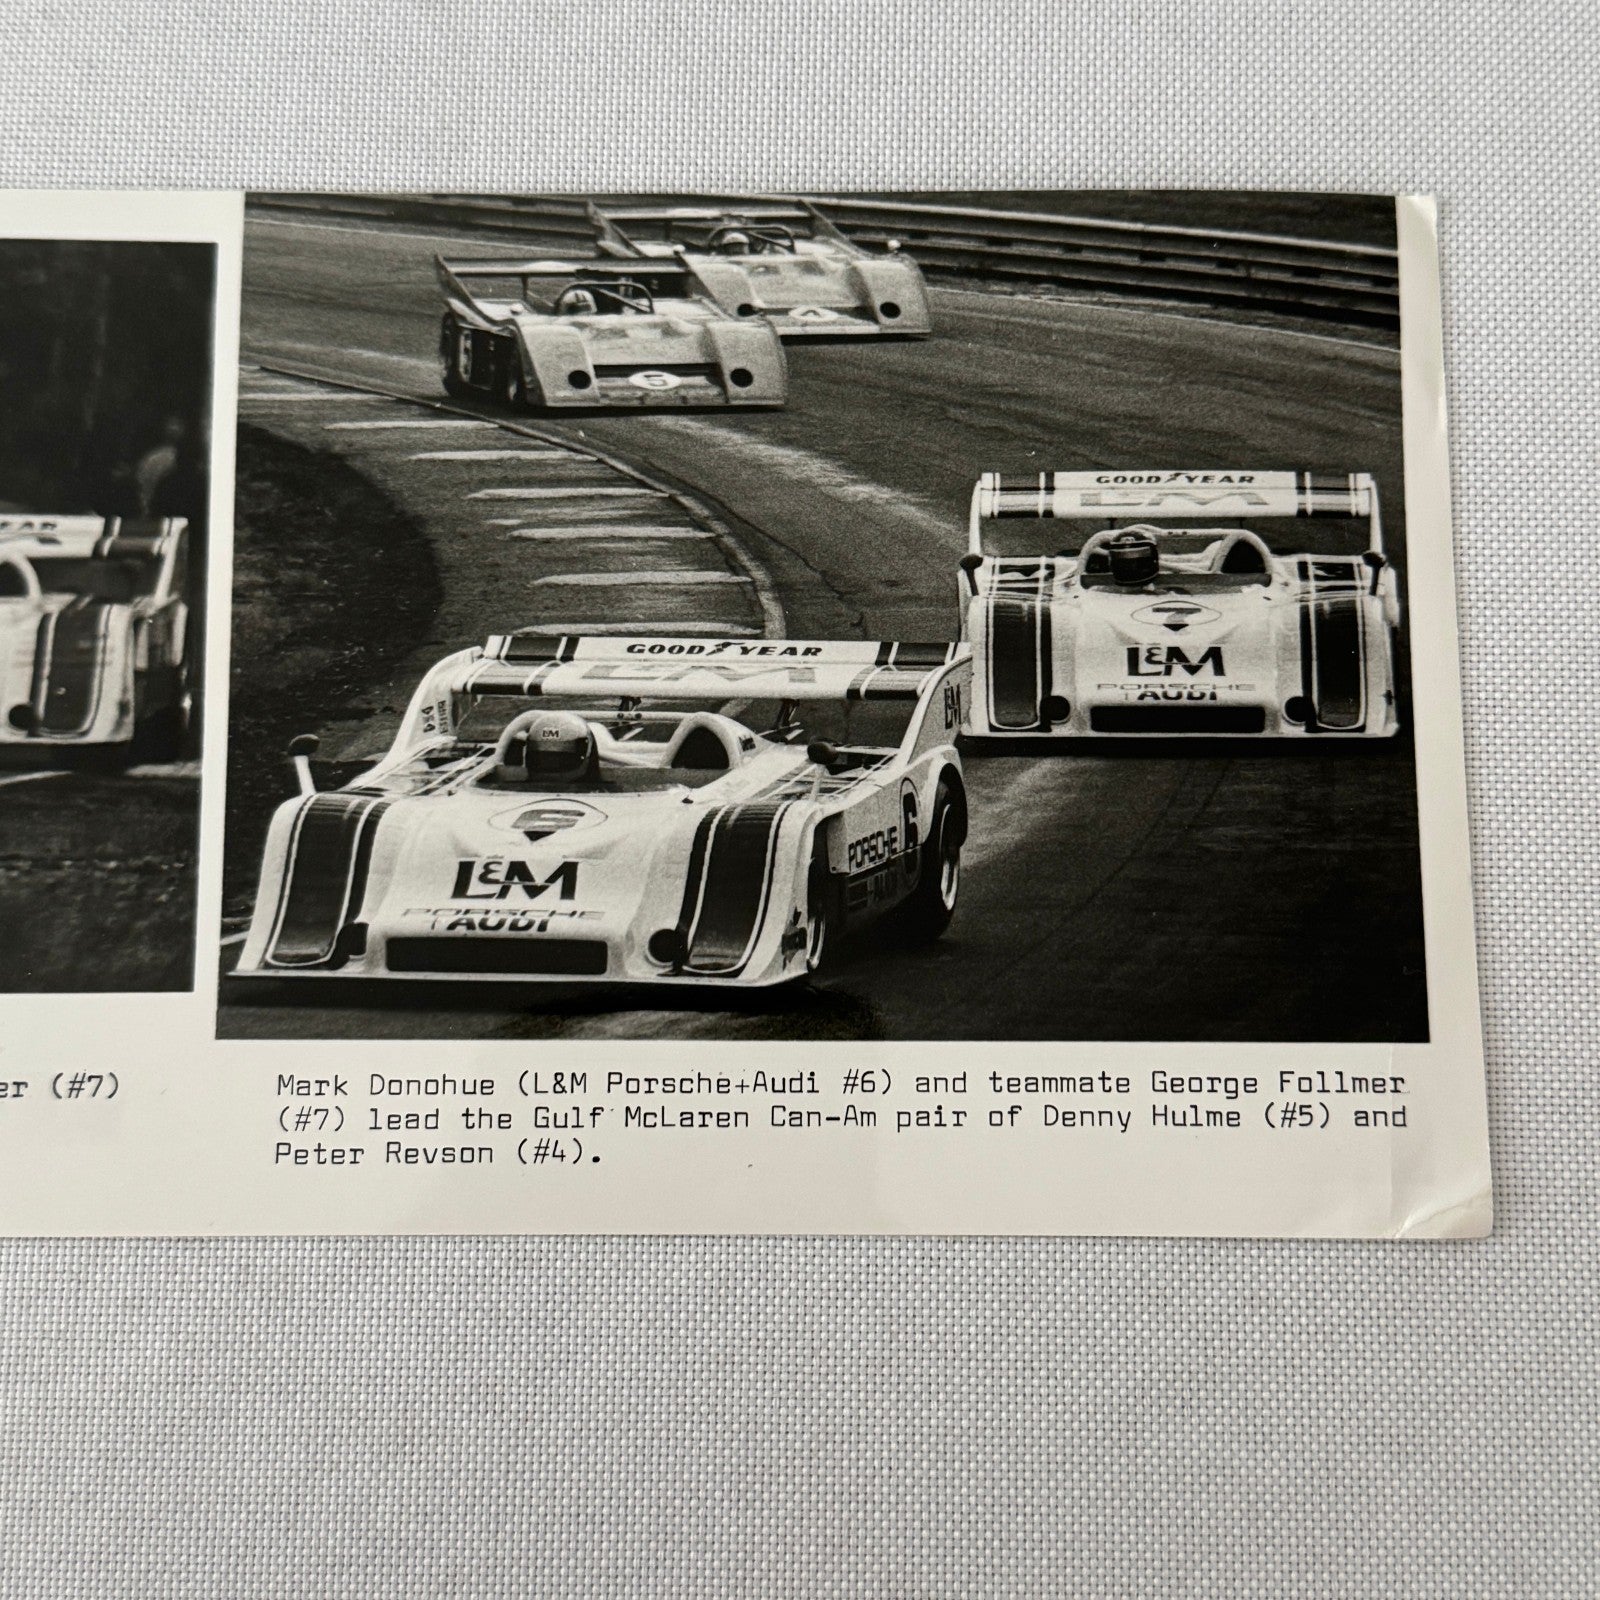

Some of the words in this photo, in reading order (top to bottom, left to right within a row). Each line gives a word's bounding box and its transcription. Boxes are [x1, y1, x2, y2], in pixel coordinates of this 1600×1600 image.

[848, 826, 899, 873] PORSCHE
[52, 1070, 119, 1100] (#7)
[277, 1073, 349, 1097] Mark
[369, 1073, 495, 1096] Donohue
[518, 1070, 588, 1098] (L&M
[606, 1070, 820, 1096] Porsche+Audi
[842, 1067, 892, 1096] #6)
[915, 1070, 968, 1094] and
[988, 1070, 1131, 1094] teammate
[1151, 1069, 1258, 1101] George
[1279, 1070, 1408, 1094] Follmer
[279, 1105, 346, 1133] (#7)
[369, 1107, 440, 1131] lead
[461, 1107, 513, 1131] the
[534, 1105, 604, 1129] Gulf
[624, 1105, 749, 1129] McLaren
[771, 1104, 877, 1128] Can-Am
[896, 1104, 968, 1134] pair
[988, 1104, 1023, 1128] of
[1043, 1103, 1132, 1134] Denny
[1151, 1103, 1242, 1128] Hulme
[1264, 1102, 1331, 1130] (#5)
[1353, 1104, 1408, 1128] and
[274, 1141, 365, 1166] Peter
[385, 1140, 494, 1165] Revson
[517, 1138, 602, 1166] (#4).
